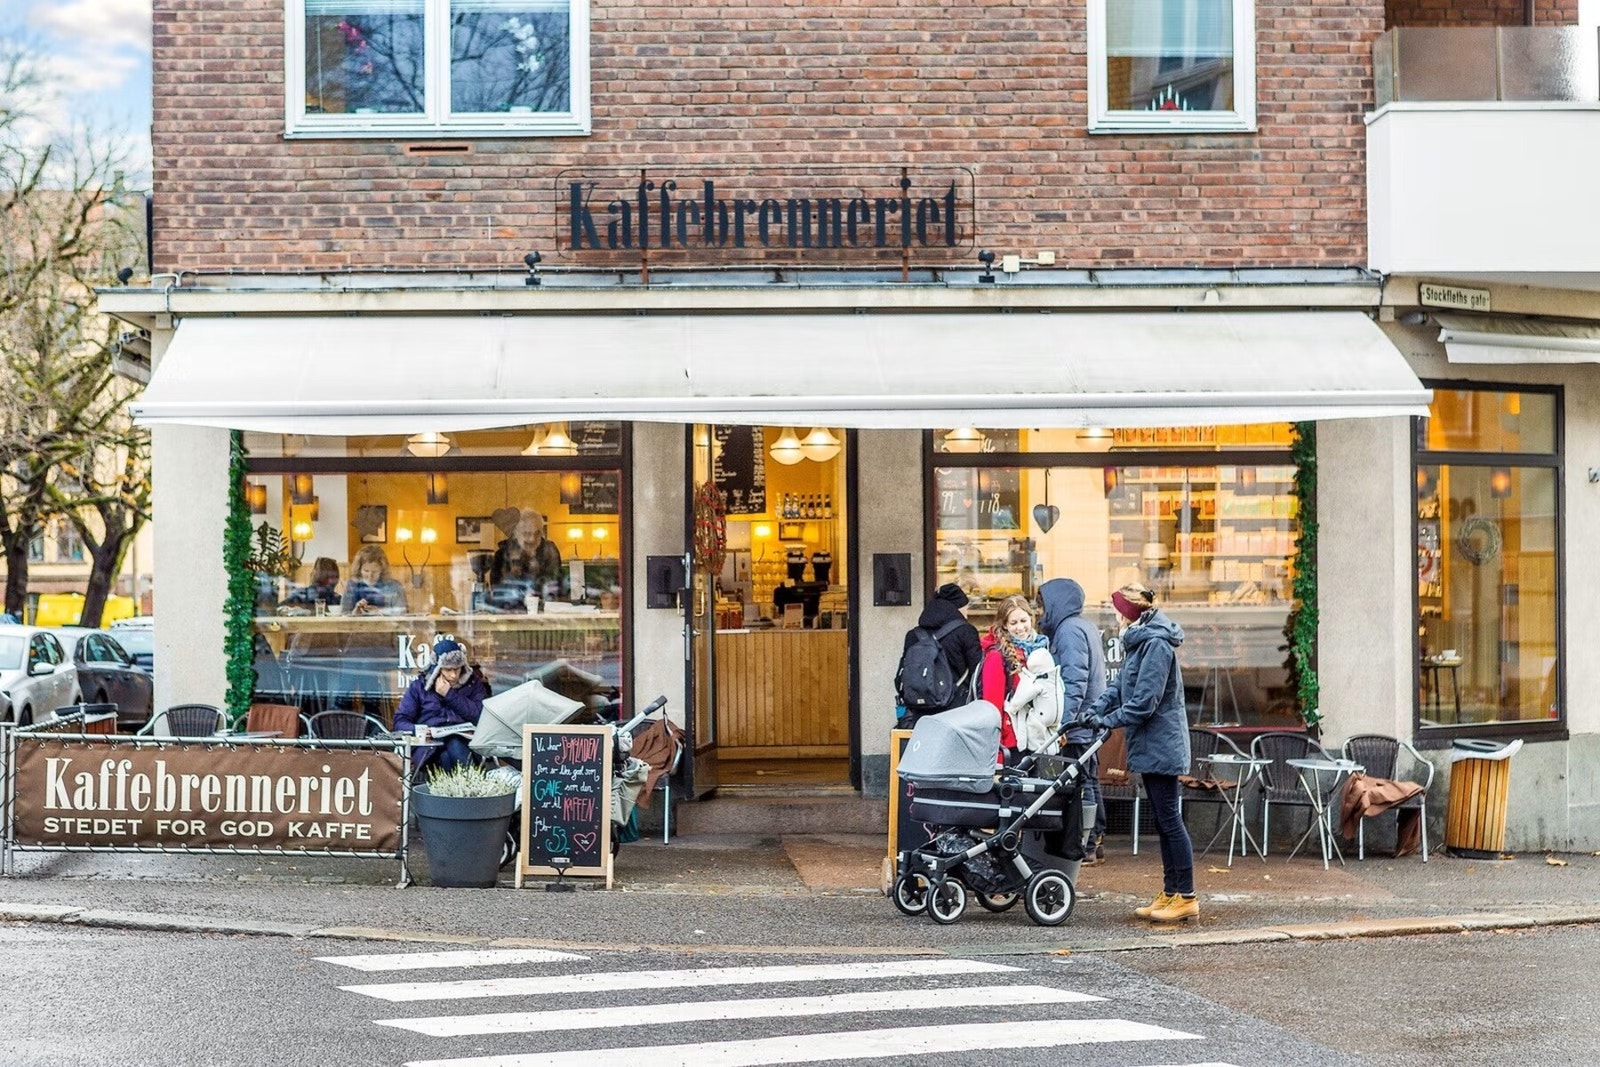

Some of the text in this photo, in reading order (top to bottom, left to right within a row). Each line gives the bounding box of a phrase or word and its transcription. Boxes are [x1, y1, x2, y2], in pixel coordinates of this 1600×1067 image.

[568, 179, 964, 250] Kaffebrenneriet
[1425, 287, 1486, 308] Stockfleths gate
[43, 757, 374, 816] Kaffebrenneriet
[563, 796, 596, 822] KAFFEN
[43, 817, 372, 840] STEDET FOR GOD KAFFE
